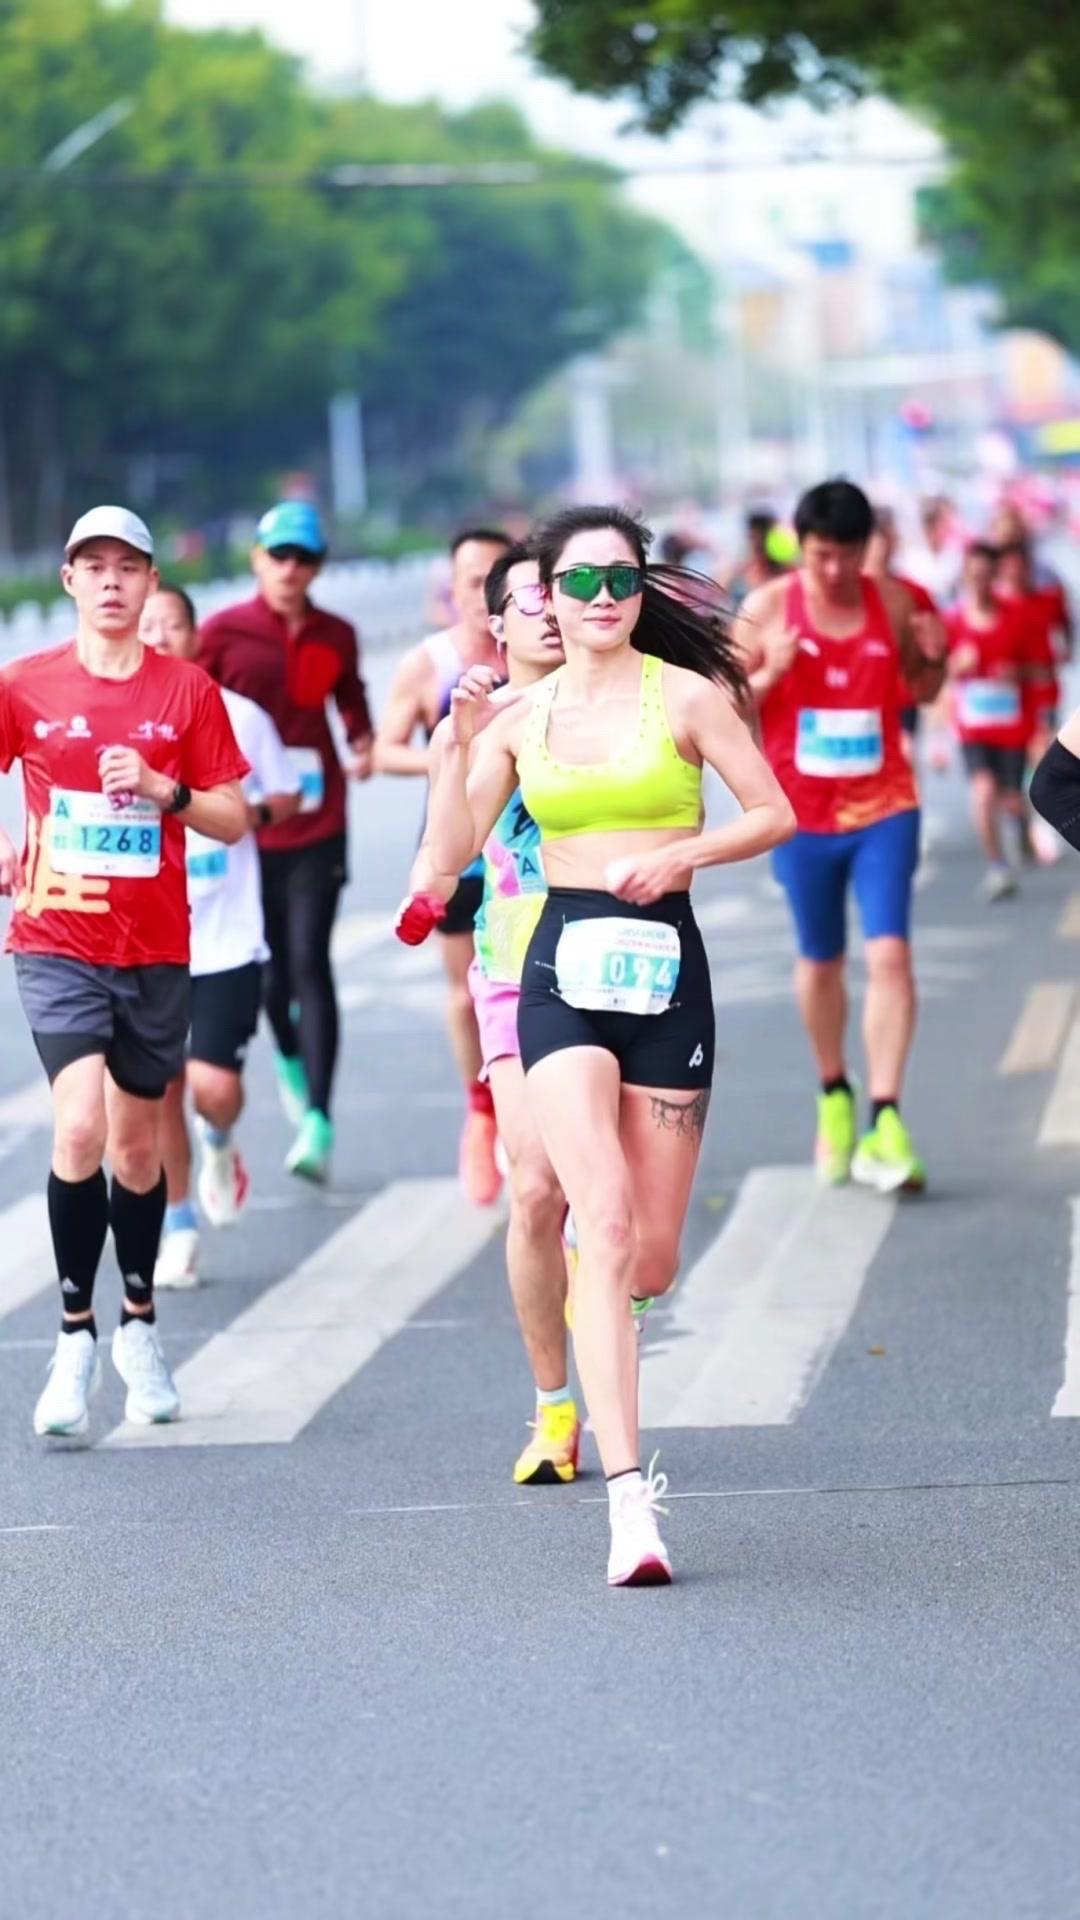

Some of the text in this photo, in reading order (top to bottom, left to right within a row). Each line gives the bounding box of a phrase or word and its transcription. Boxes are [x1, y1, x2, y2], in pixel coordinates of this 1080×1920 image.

[55, 798, 70, 819] A
[81, 826, 153, 855] 1268
[521, 856, 538, 877] A
